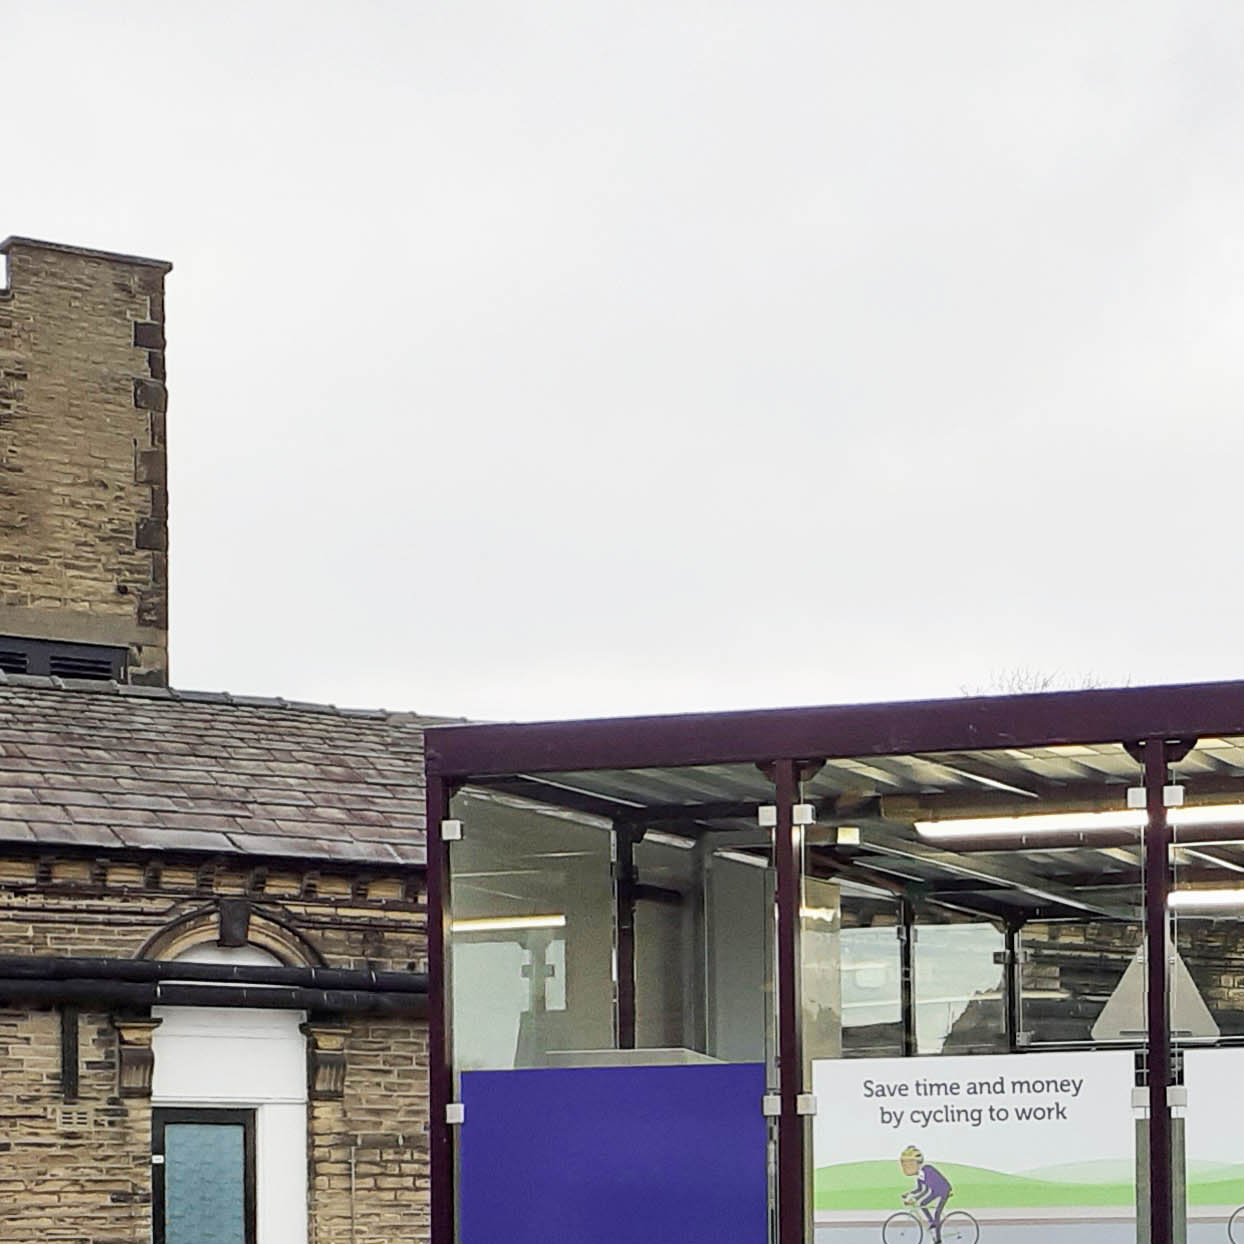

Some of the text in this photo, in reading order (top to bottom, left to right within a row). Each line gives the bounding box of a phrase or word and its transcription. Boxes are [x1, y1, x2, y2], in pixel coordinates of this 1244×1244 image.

[863, 1076, 1084, 1098] Save time and money
[879, 1101, 1068, 1130] by cycling to work
